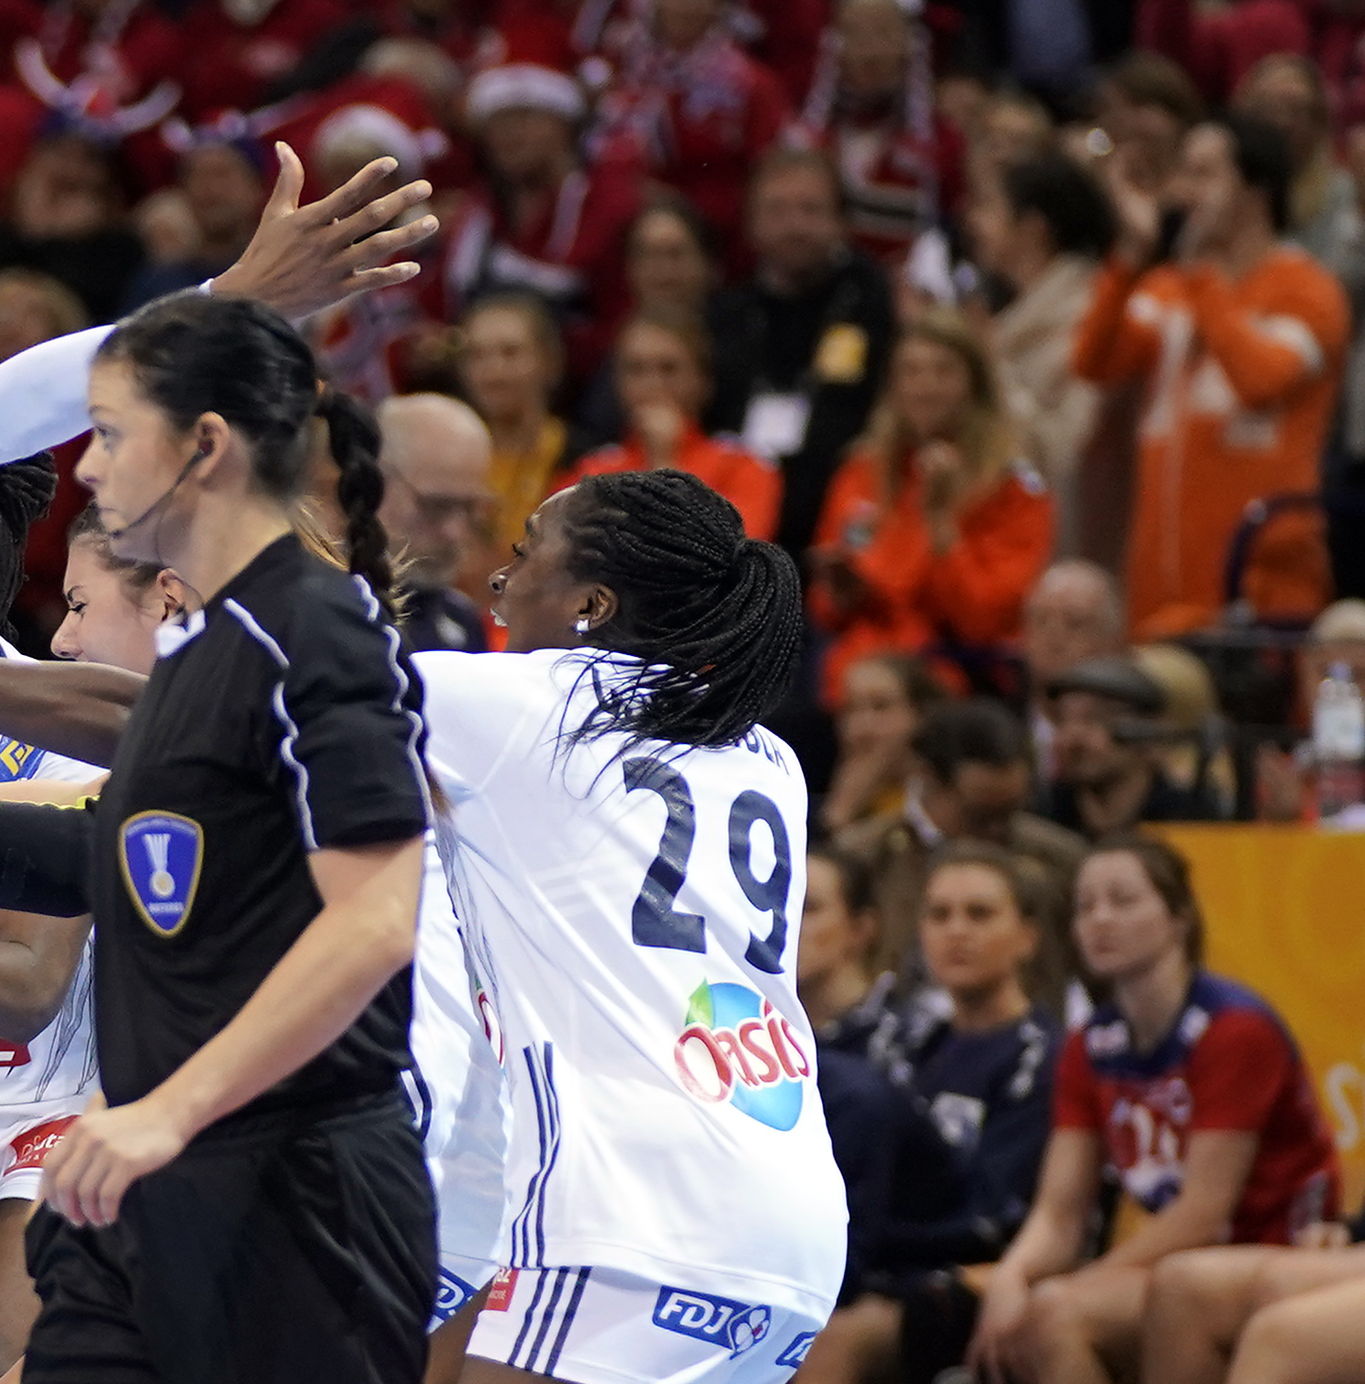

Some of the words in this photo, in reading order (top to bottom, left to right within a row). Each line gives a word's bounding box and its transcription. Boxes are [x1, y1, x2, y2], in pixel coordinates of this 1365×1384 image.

[623, 756, 793, 975] 29
[674, 997, 811, 1102] Oasis
[659, 1291, 734, 1335] FDJ
